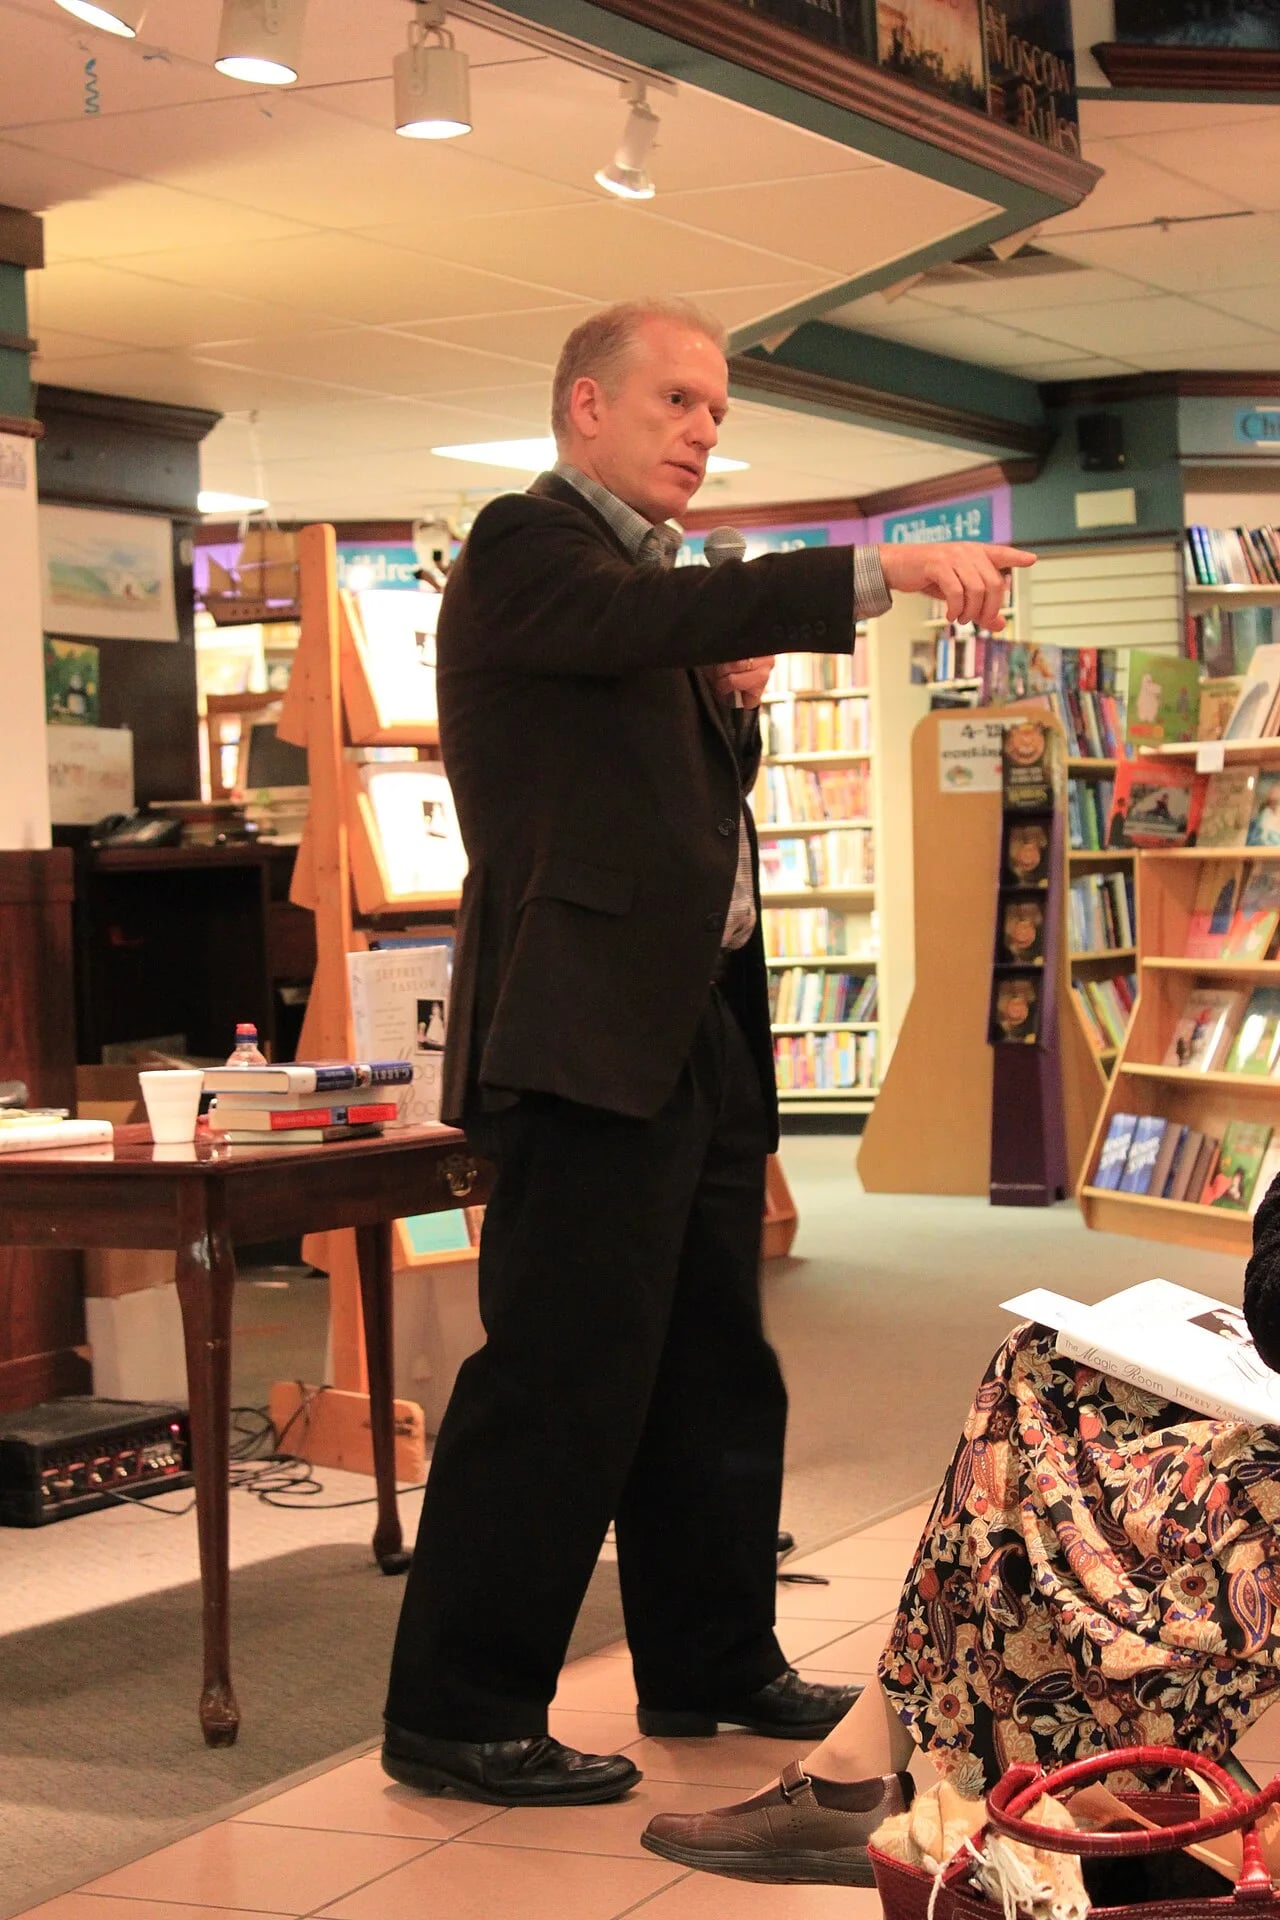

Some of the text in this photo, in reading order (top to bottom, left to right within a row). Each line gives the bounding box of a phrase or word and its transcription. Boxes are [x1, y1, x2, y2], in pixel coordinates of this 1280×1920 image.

[398, 1085, 437, 1122] Roo
[1064, 1339, 1079, 1351] The
[1079, 1346, 1118, 1372] Magic
[1122, 1363, 1164, 1392] Room
